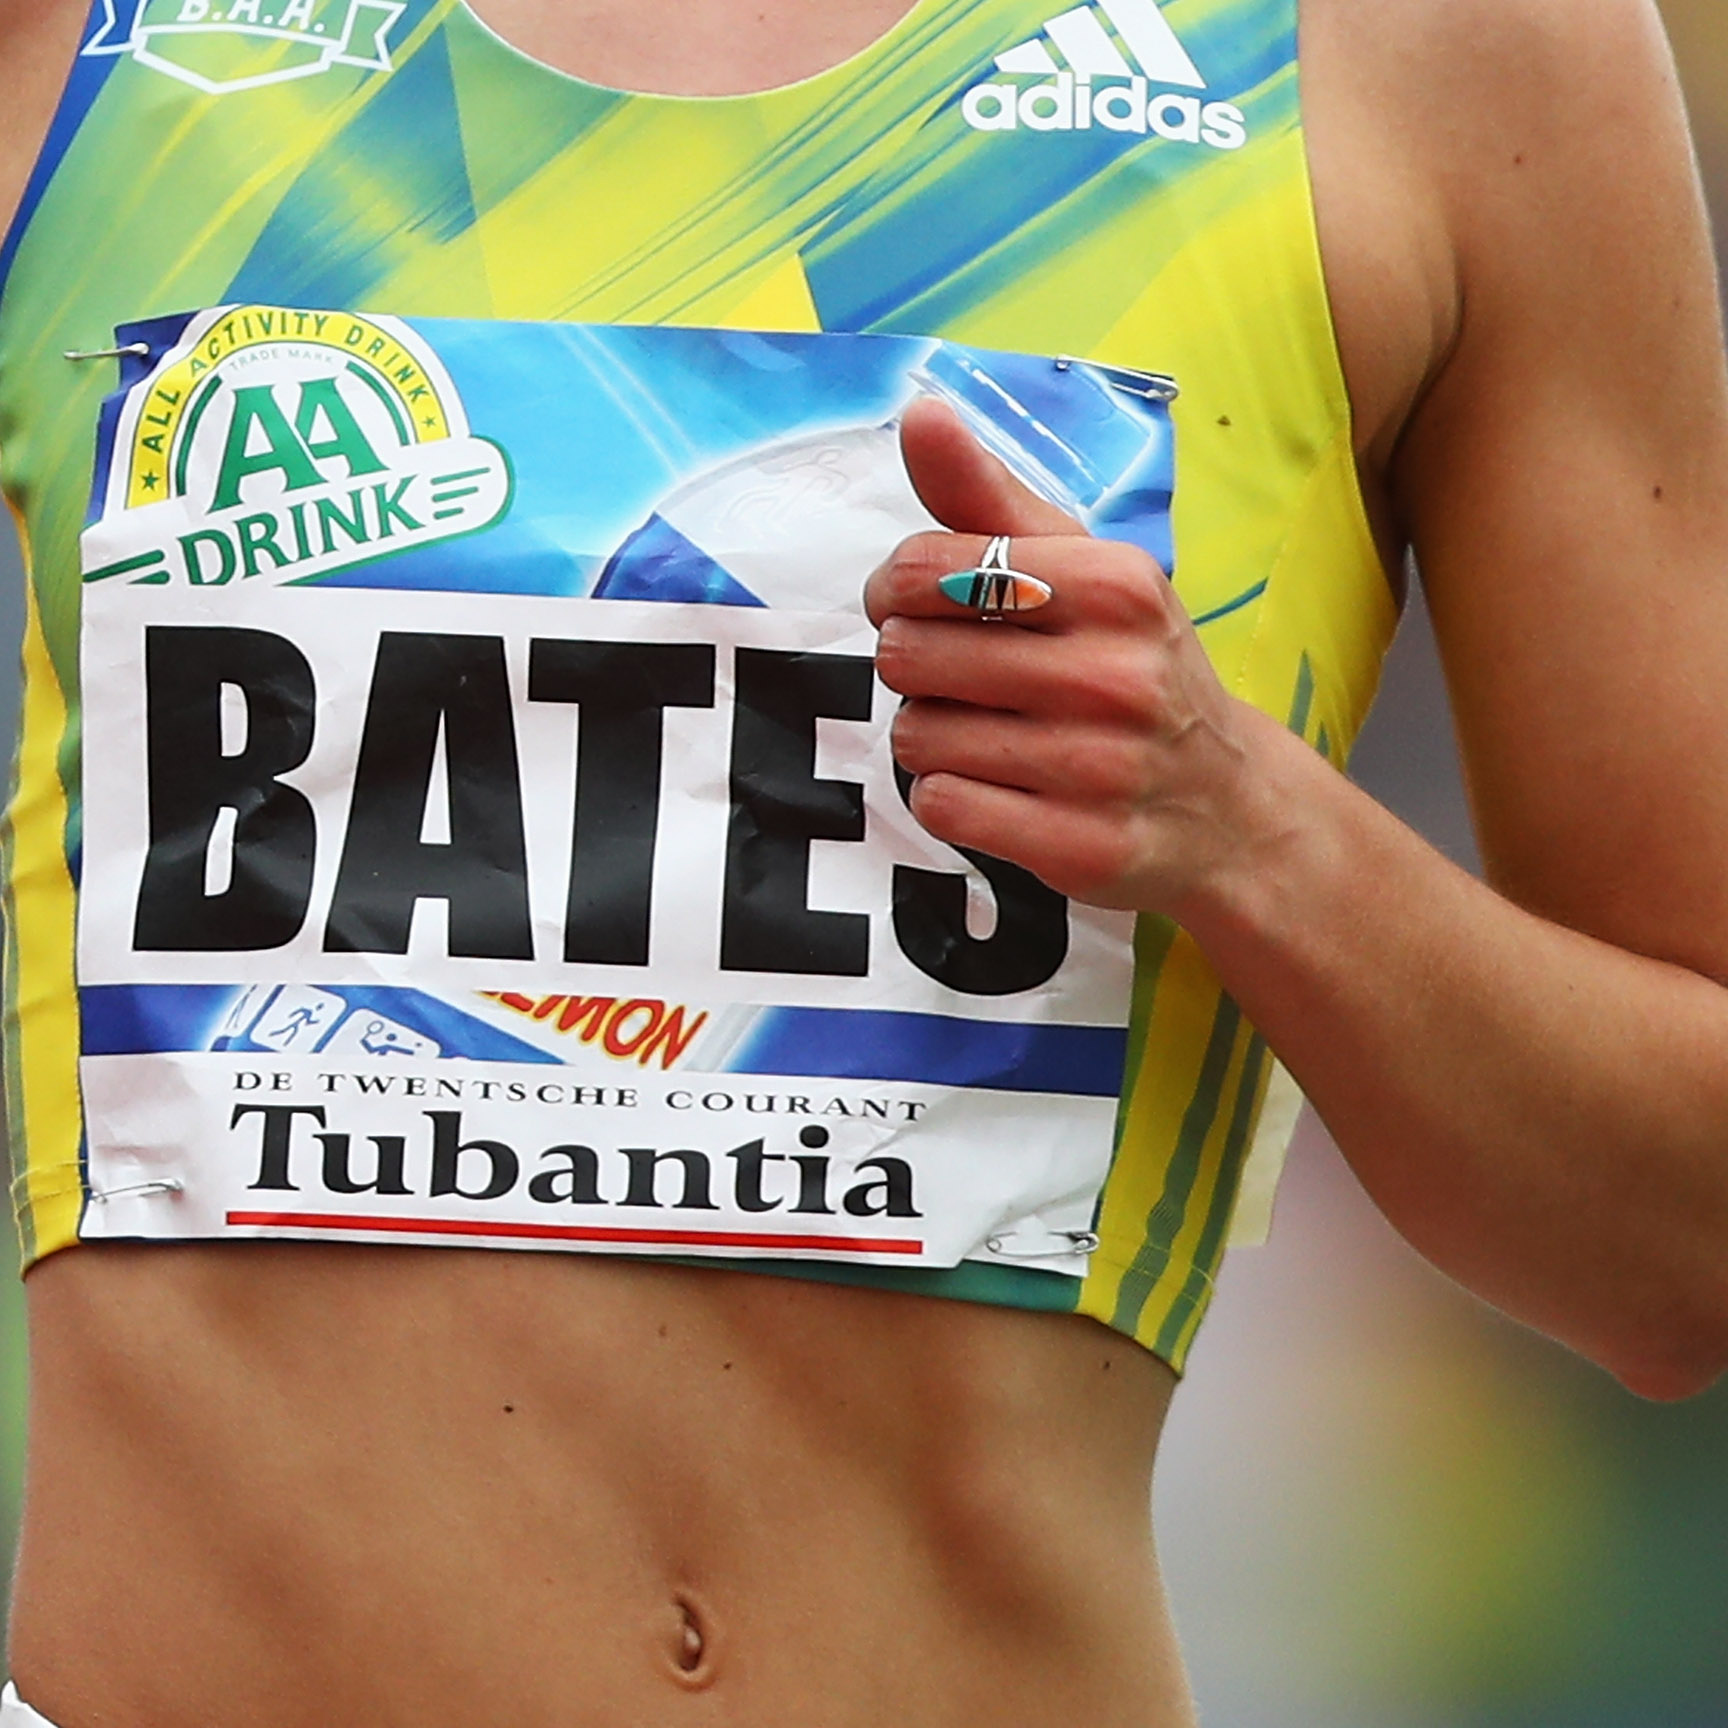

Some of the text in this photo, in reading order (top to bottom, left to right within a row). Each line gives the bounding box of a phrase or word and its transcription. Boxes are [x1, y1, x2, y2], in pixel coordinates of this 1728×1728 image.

[961, 71, 1247, 150] adidas
[140, 312, 430, 454] ALL ACTIVITY DRINK
[229, 347, 334, 371] TRADE MARK
[207, 376, 391, 514] AA
[177, 474, 426, 586] DRINK
[233, 1072, 927, 1122] DE TWENTSCHE COURANT
[229, 1102, 924, 1219] Tubantia
